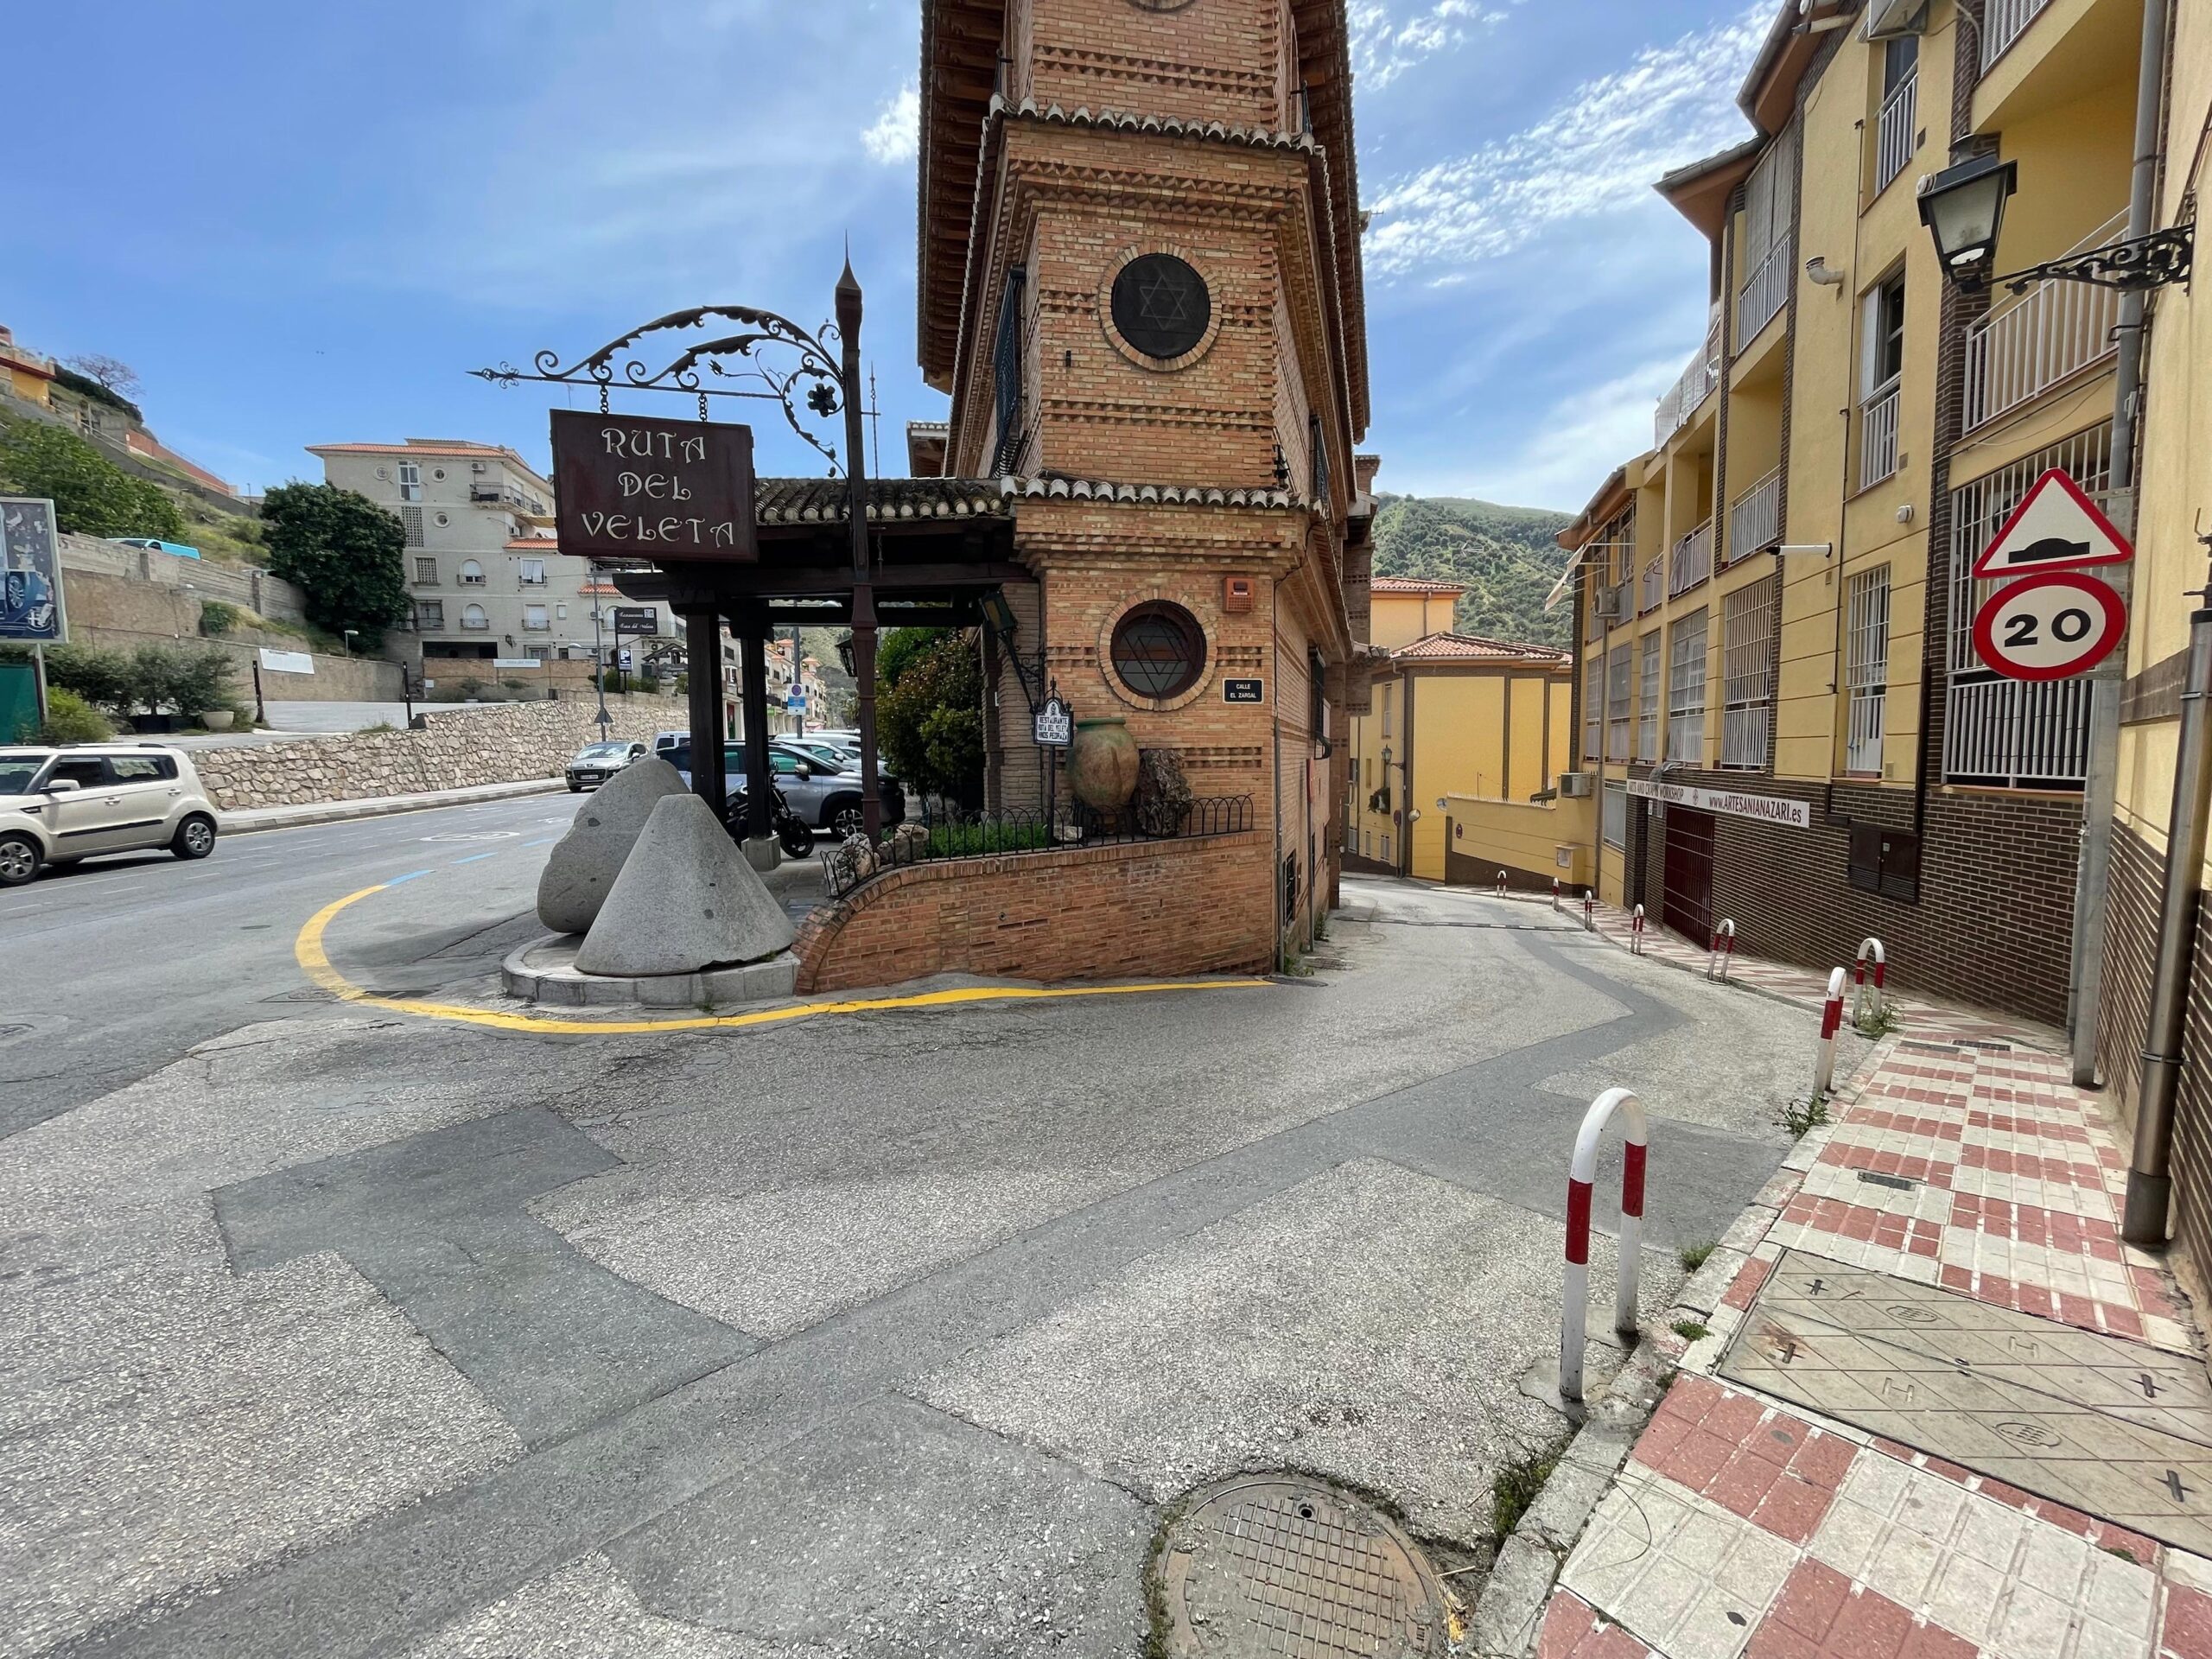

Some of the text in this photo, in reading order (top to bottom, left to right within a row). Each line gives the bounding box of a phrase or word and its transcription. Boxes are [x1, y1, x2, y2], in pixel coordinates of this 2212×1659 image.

[601, 428, 706, 464] RUTA
[618, 471, 691, 500] DEL
[581, 511, 734, 548] VELETA
[2004, 607, 2092, 648] 20
[1659, 785, 1683, 802] WORKSHOP
[1708, 795, 1802, 823] www.ARTESANIANAZARI.es
